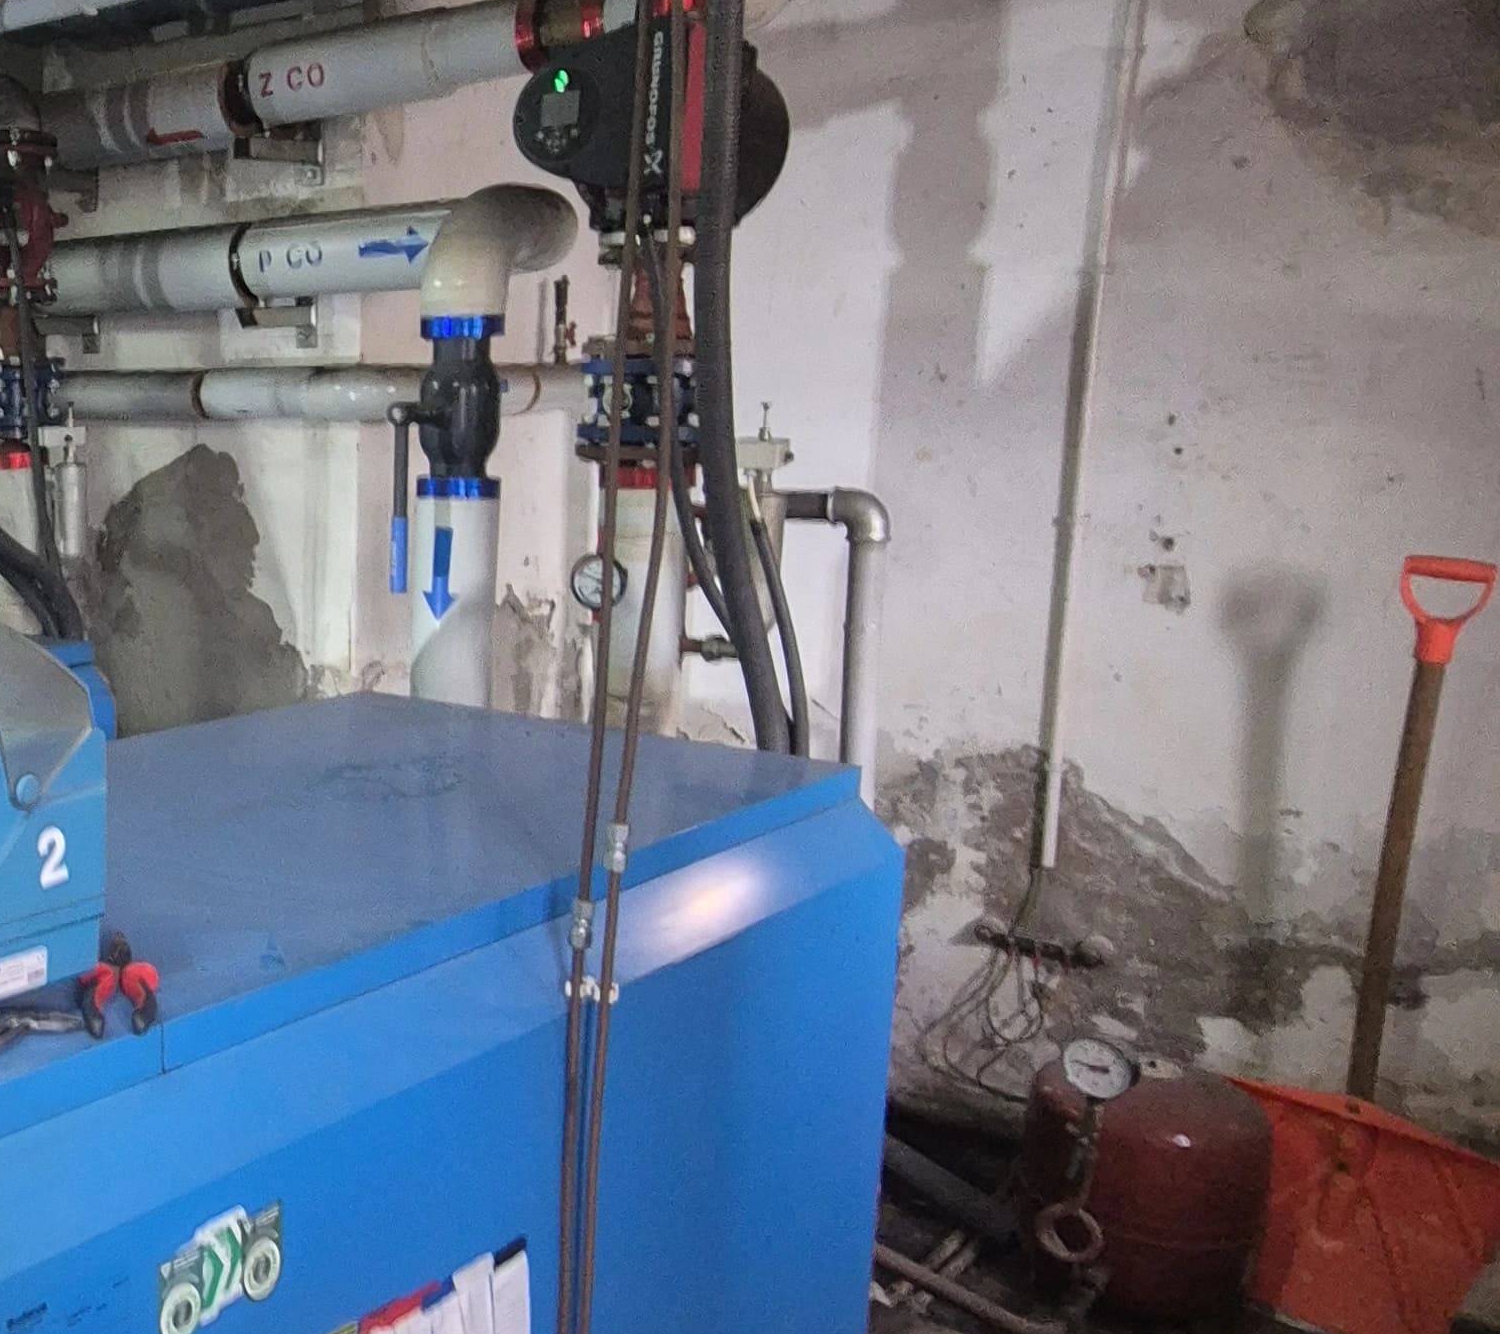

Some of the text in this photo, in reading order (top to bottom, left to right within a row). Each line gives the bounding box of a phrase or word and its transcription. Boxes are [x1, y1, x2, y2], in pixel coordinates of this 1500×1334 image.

[259, 63, 325, 98] Z CO
[259, 242, 323, 273] P CO
[37, 826, 69, 890] 2
